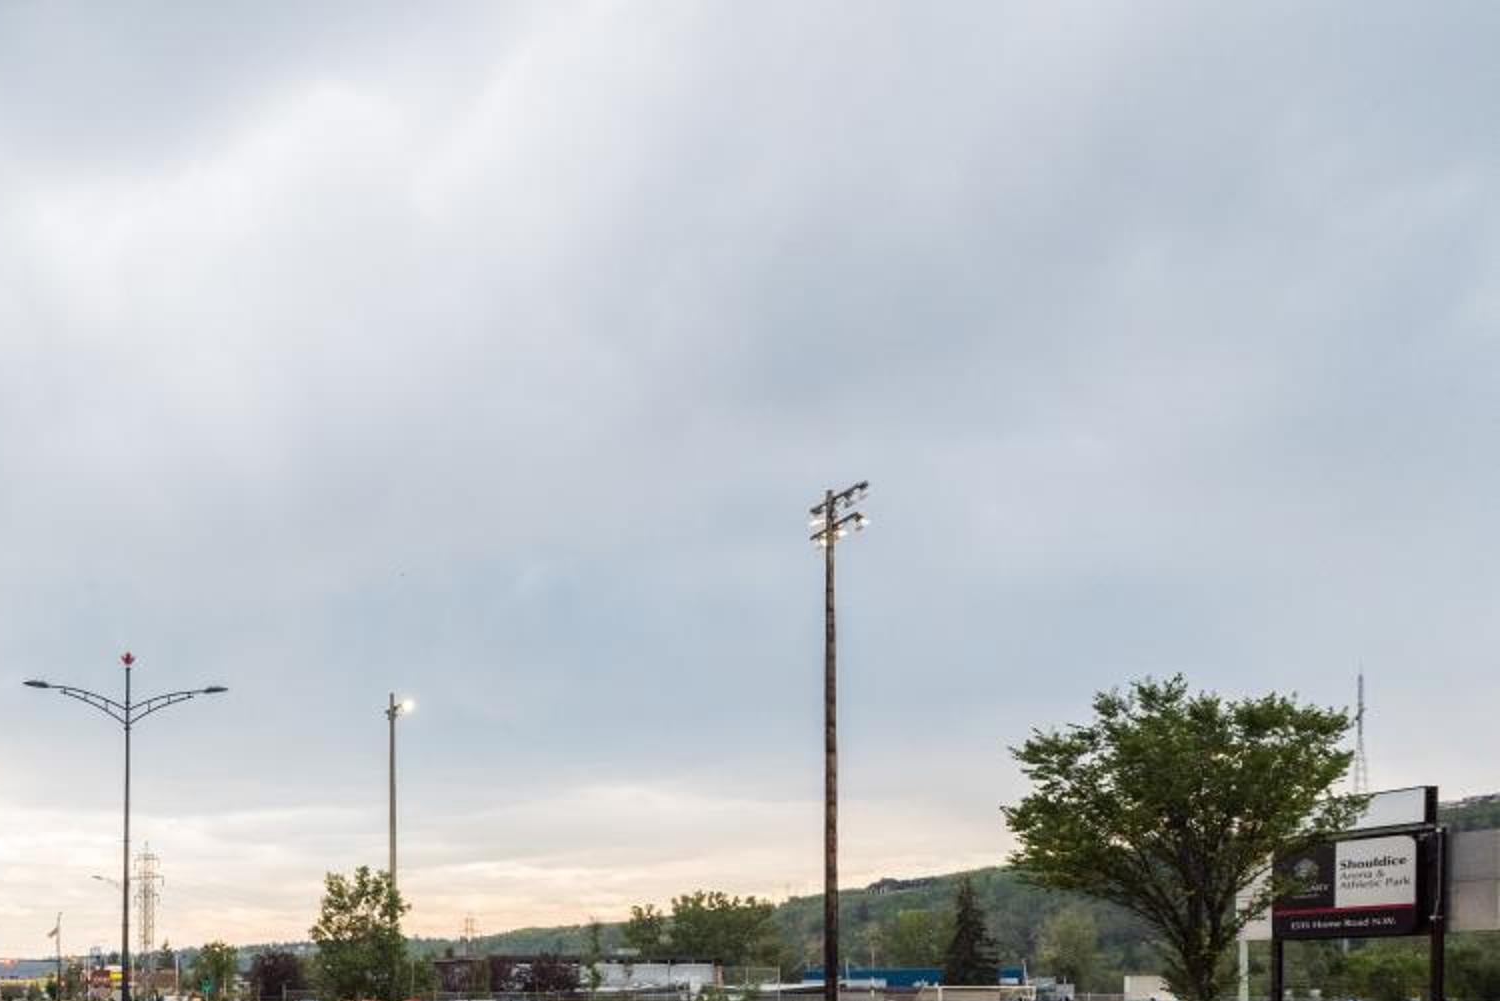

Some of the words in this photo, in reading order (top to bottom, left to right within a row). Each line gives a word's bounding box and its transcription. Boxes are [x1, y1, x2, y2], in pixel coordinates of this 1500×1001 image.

[1339, 855, 1408, 870] Shouldice
[1385, 876, 1411, 887] Park
[1344, 917, 1369, 927] Road
